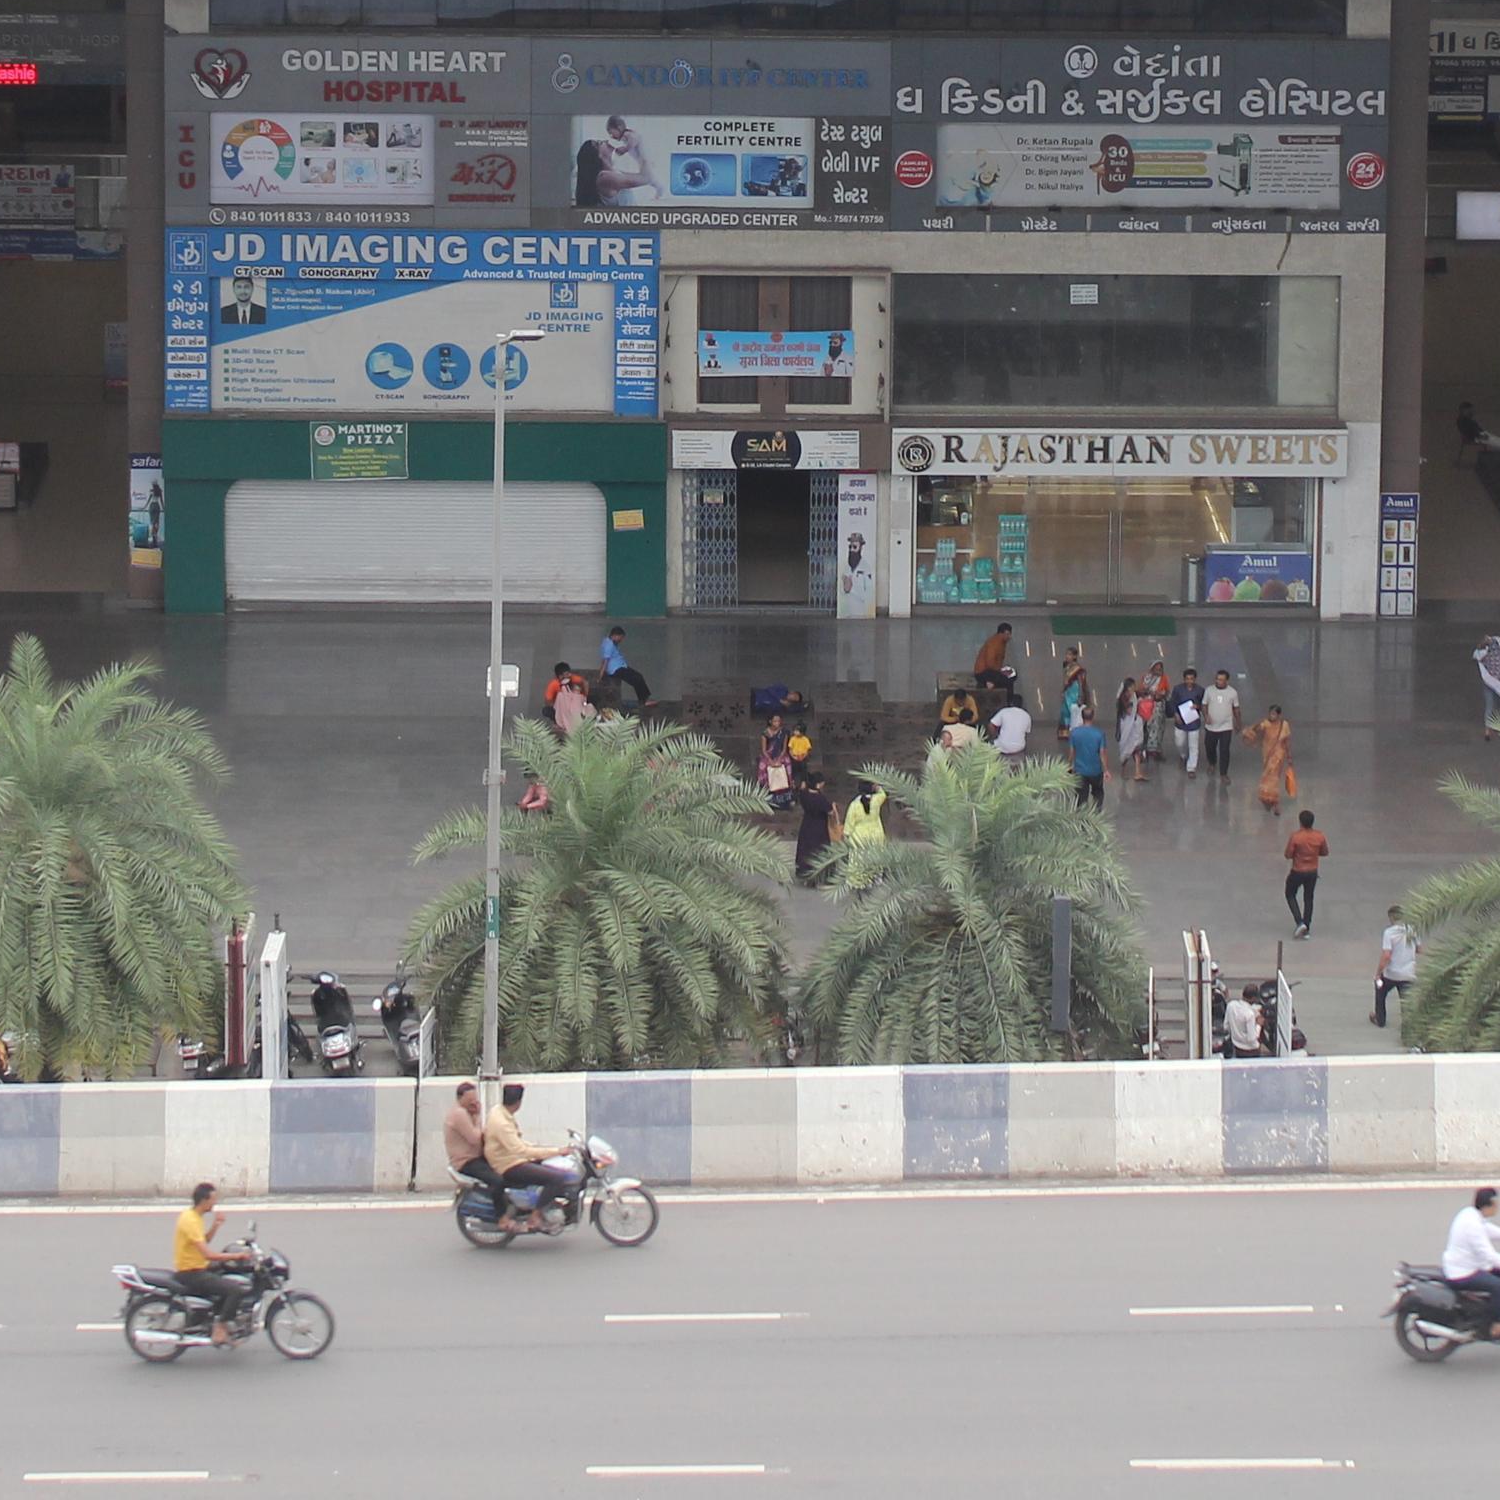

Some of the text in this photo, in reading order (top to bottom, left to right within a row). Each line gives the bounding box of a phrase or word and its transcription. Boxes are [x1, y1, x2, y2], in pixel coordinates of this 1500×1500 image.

[282, 50, 506, 73] GOLDEN HEART
[719, 69, 762, 88] IVF
[767, 68, 868, 90] CENTER
[324, 80, 466, 103] HOSPITAL
[941, 78, 1047, 115] કિડની
[1061, 90, 1084, 115] &
[1239, 78, 1386, 116] હોસ્પિટલ
[704, 121, 775, 132] COMPLETE
[677, 136, 802, 147] FERTILITY CENTRE
[1017, 137, 1093, 148] Dr. Ketan Rupala
[1108, 146, 1128, 159] 30
[855, 157, 880, 172] IVF
[1356, 163, 1375, 178] 24
[1109, 174, 1126, 183] ICU
[1038, 182, 1058, 191] Nikul
[584, 212, 798, 226] ADVANCED UPGRADED CENTER
[212, 233, 654, 267] JD IMAGING CENTRE
[235, 267, 283, 277] CT SCAN
[300, 268, 377, 278] SONOGRAPHY
[398, 269, 431, 278] X-RAY
[463, 269, 644, 281] Advanced & Trusted Imaging Centre
[624, 286, 649, 301] जे डी
[525, 312, 603, 321] JD IMAGING
[538, 324, 591, 333] CENTRE
[347, 435, 394, 445] PIZZA
[747, 438, 786, 452] SAM
[942, 434, 1338, 471] RAJASTHAN SWEETS
[1385, 497, 1414, 507] Amul
[1241, 555, 1277, 567] Amul
